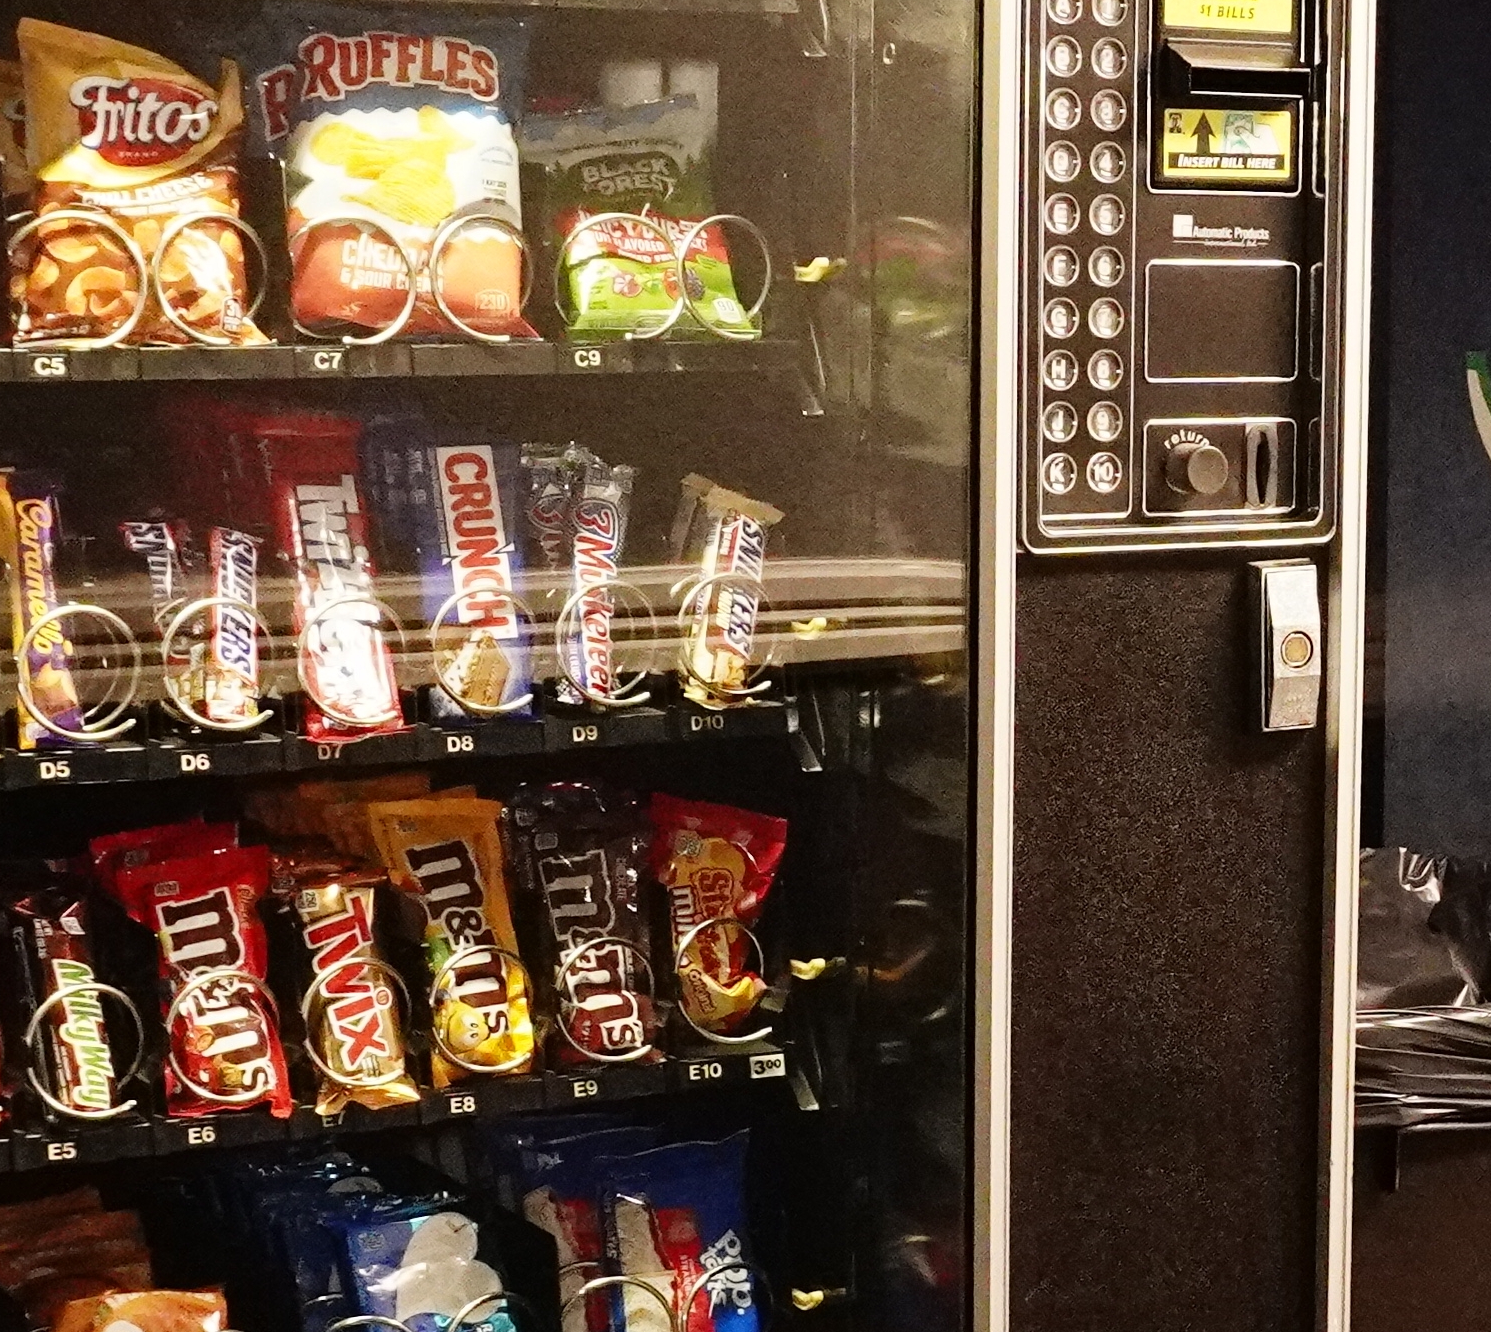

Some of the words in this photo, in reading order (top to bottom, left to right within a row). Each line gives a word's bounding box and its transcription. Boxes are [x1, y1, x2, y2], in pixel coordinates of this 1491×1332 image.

[1216, 5, 1256, 20] BILLS
[299, 30, 499, 101] RUFFLES
[70, 75, 219, 151] Fritos
[1177, 152, 1221, 169] INSERT
[1220, 154, 1247, 169] BILL
[1246, 155, 1278, 170] HERE
[1192, 225, 1234, 239] Automatic
[1234, 226, 1270, 239] Products
[34, 356, 65, 376] C5
[313, 349, 343, 370] C7
[573, 348, 602, 368] C9
[1165, 429, 1211, 451] return
[442, 450, 509, 629] CRUNCH
[572, 724, 599, 743] D9
[690, 714, 724, 733] D10
[446, 734, 475, 753] D8
[39, 761, 71, 781] D5
[180, 752, 211, 772] D6
[72, 1043, 115, 1110] Way
[688, 1061, 724, 1080] E10
[572, 1080, 599, 1098] E9
[450, 1095, 477, 1113] E8
[187, 1126, 217, 1145] E6
[47, 1141, 77, 1161] E5
